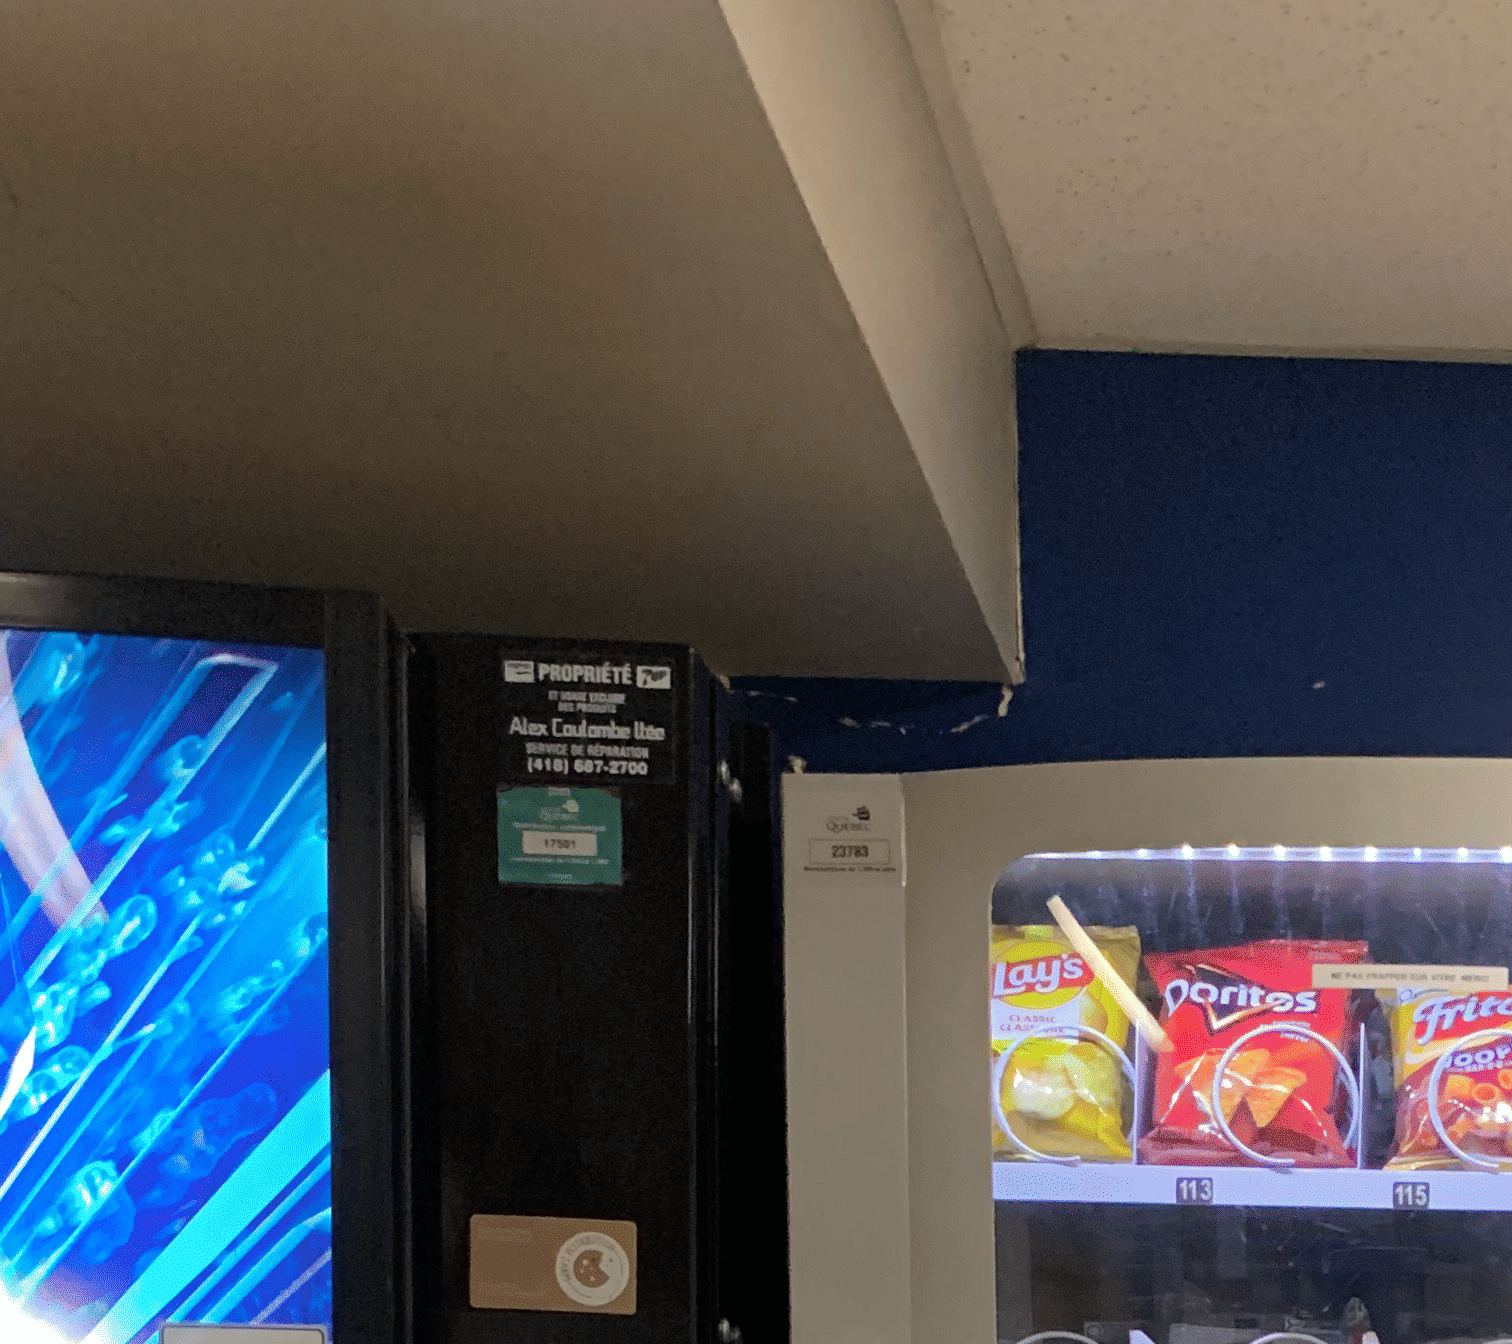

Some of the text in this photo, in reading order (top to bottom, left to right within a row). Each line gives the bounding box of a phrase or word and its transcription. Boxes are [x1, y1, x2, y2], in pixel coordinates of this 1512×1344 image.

[538, 661, 633, 685] PROPRIÉTÉ
[509, 716, 549, 737] Alex
[831, 844, 870, 858] 23783
[994, 953, 1084, 996] Lay's
[1164, 978, 1317, 1017] Doritos
[1179, 1179, 1212, 1200] 113
[1394, 1185, 1428, 1206] 115
